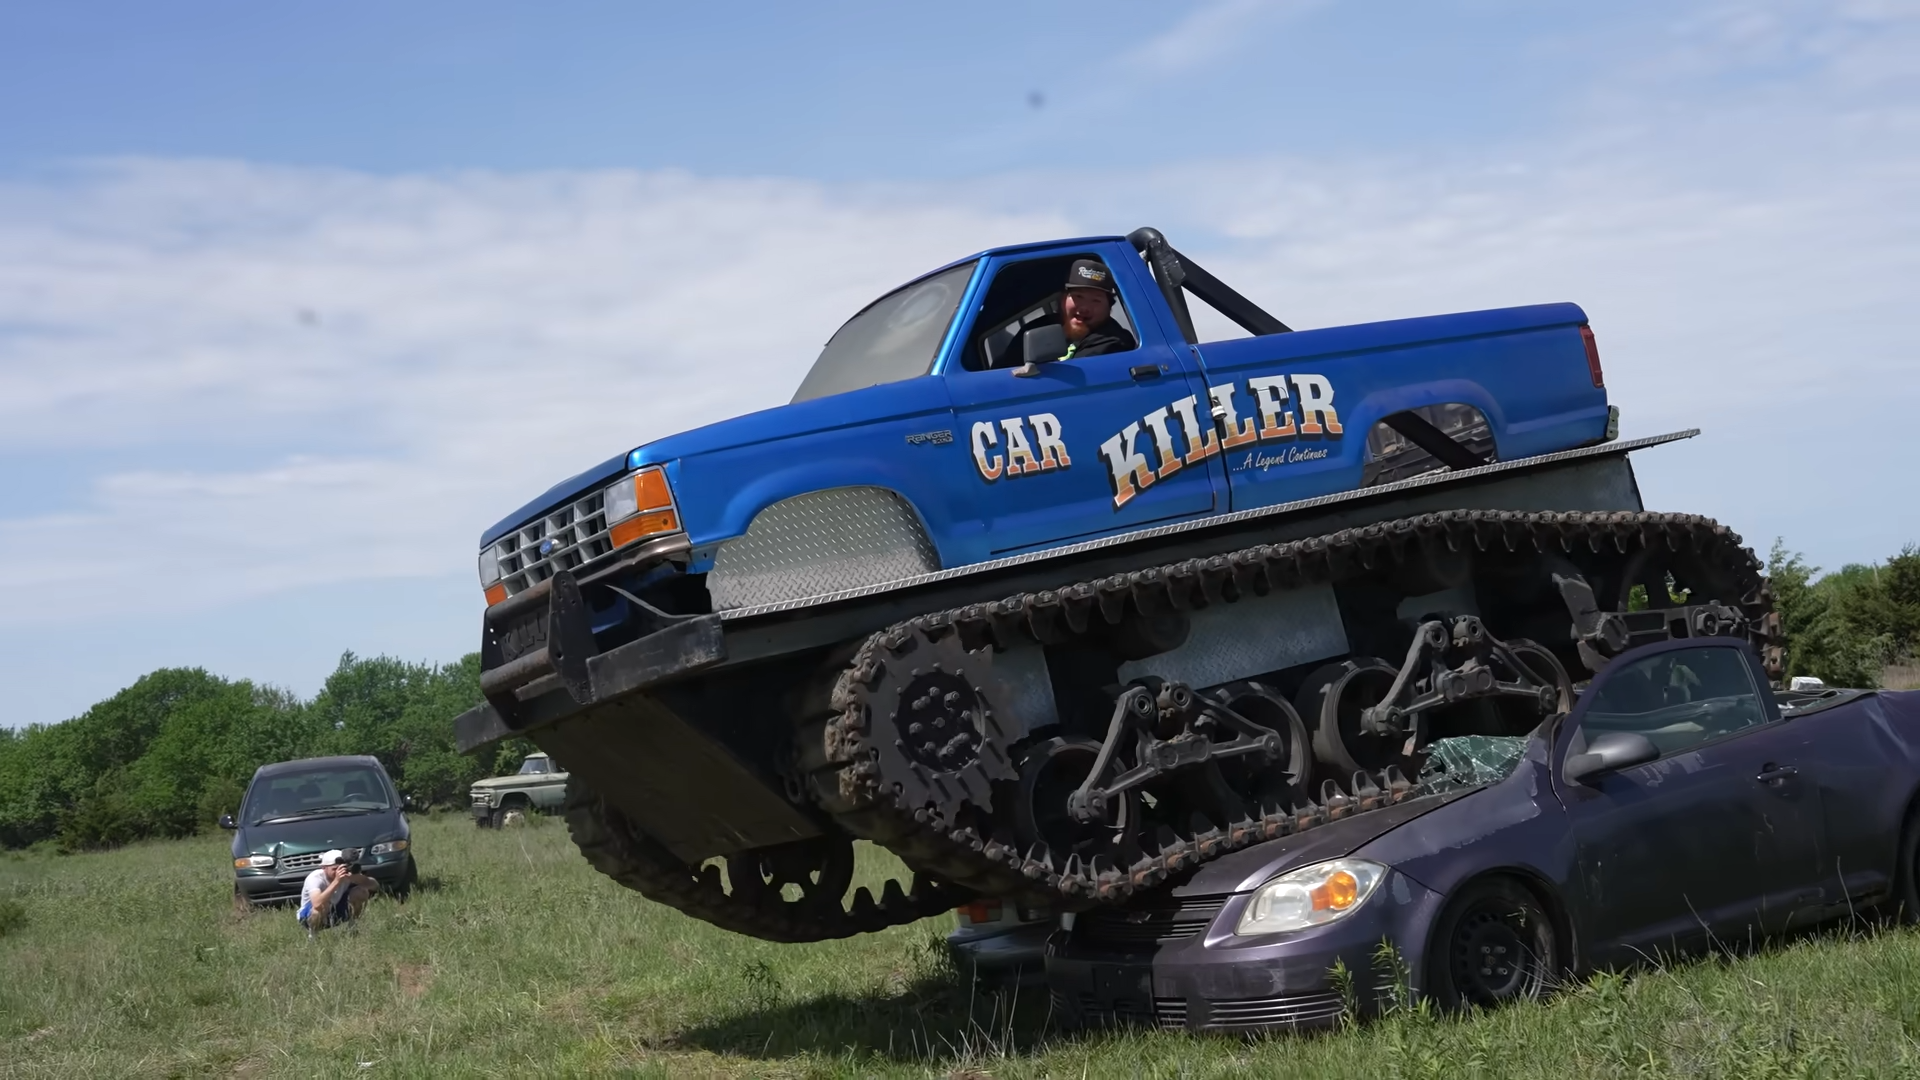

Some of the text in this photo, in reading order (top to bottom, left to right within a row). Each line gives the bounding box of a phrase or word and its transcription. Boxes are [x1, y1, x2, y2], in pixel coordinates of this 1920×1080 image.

[970, 373, 1343, 507] CAR KILLER
[1255, 449, 1287, 471] Legend
[1288, 446, 1328, 463] Continues
